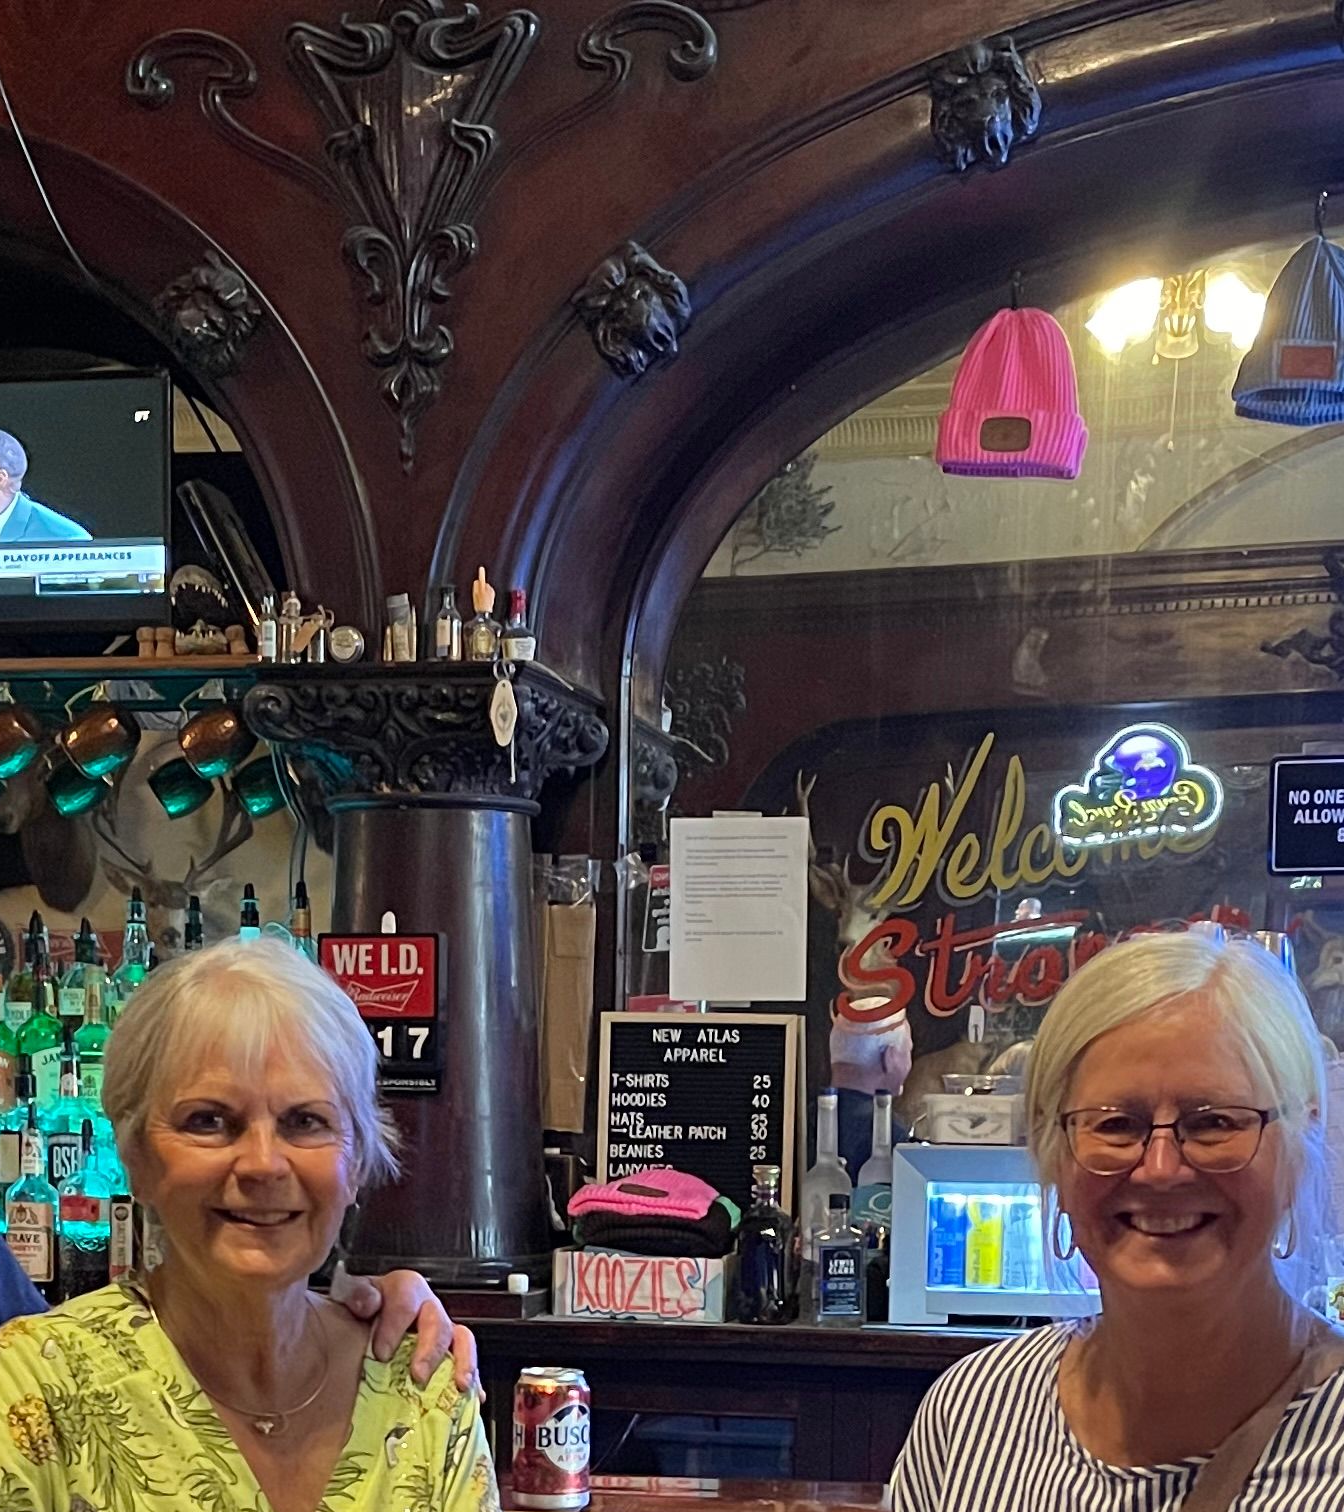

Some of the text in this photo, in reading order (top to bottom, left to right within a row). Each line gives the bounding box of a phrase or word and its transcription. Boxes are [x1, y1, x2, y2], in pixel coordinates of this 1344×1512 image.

[3, 553, 49, 562] PLAYOFF
[52, 551, 133, 561] APPEARANCES
[1288, 790, 1310, 805] NO
[1313, 788, 1344, 804] ONE
[332, 943, 424, 976] WE I.D.
[652, 1028, 740, 1044] NEW ATLAS
[663, 1048, 727, 1063] APPAREL
[612, 1073, 771, 1089] T-SHIRTS 25
[611, 1092, 770, 1108] HOODIES 40
[610, 1112, 768, 1128] HATS 25
[629, 1124, 768, 1140] LEATHER PATCH 30
[609, 1143, 766, 1160] BEANIES 25
[576, 1252, 706, 1319] KOOZIES
